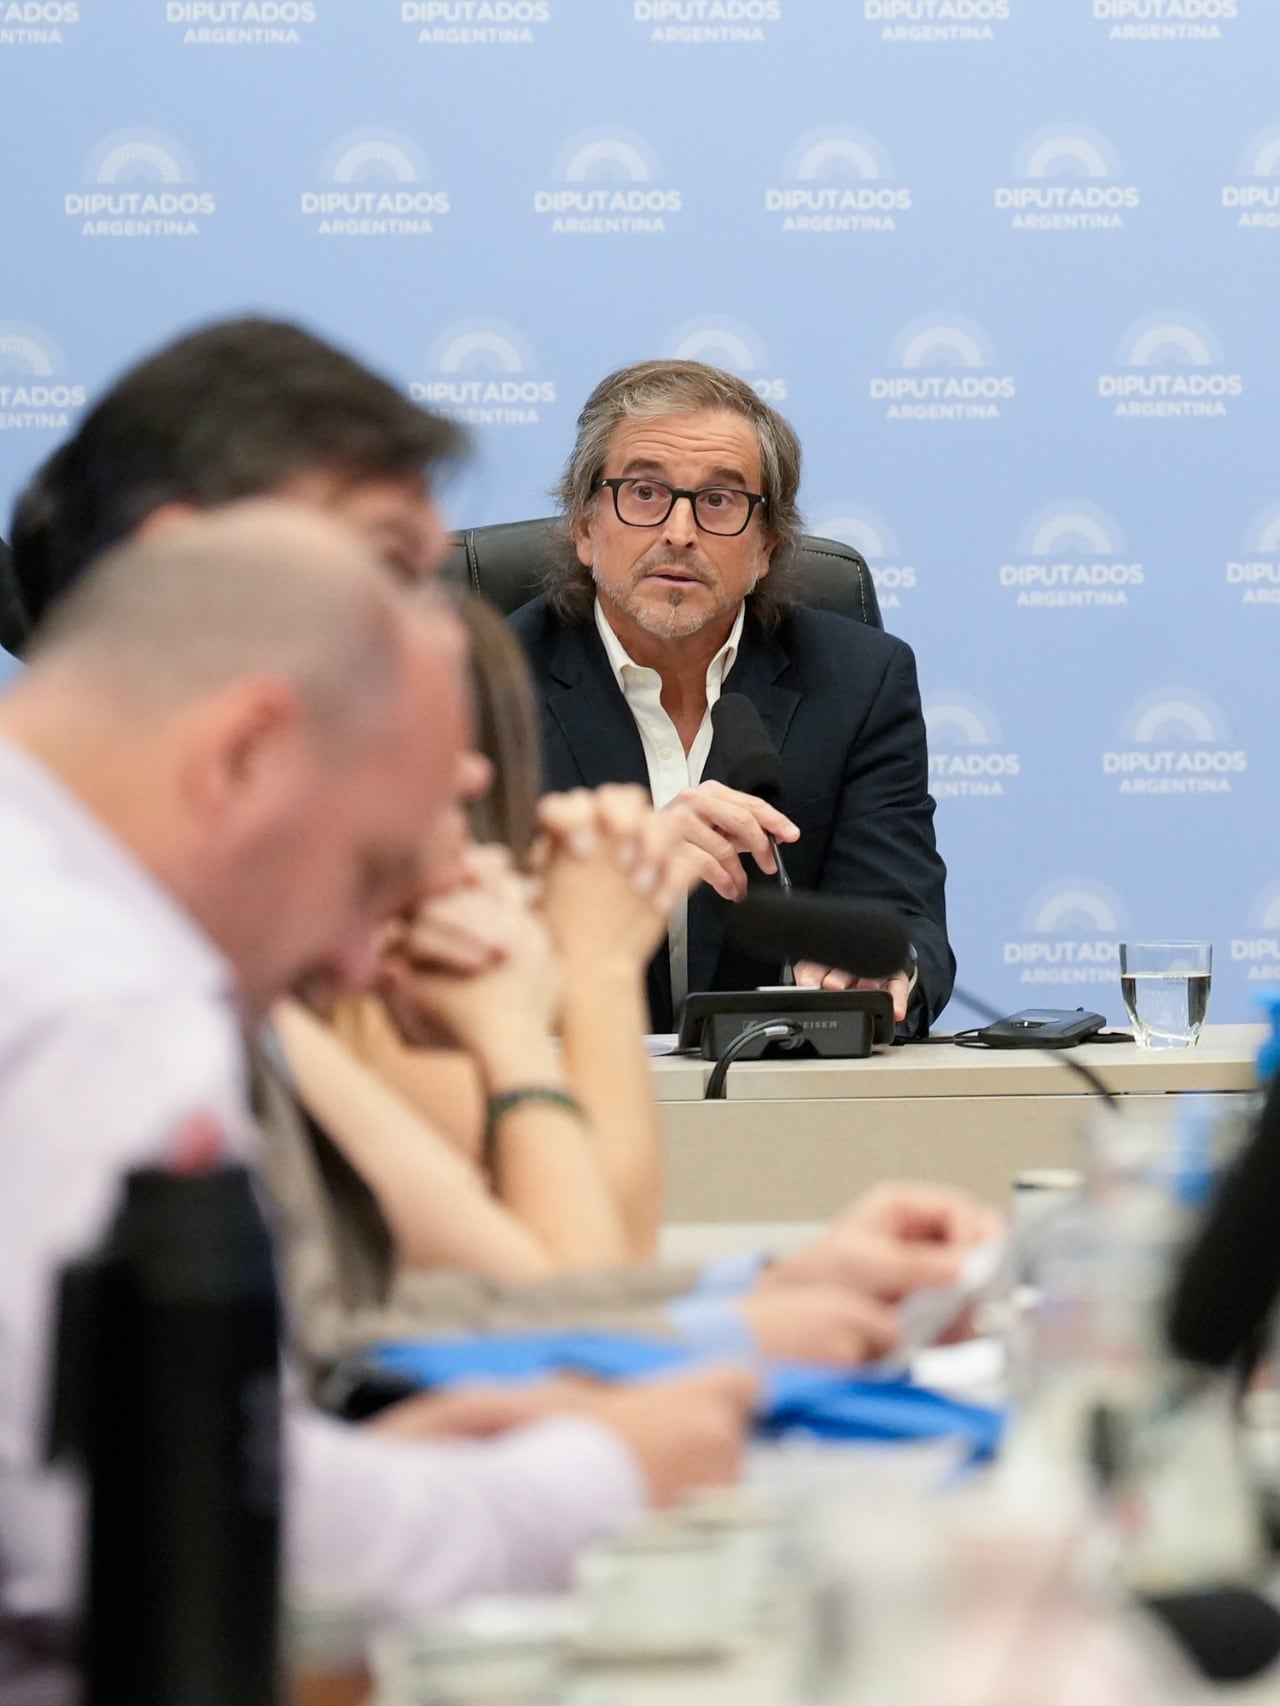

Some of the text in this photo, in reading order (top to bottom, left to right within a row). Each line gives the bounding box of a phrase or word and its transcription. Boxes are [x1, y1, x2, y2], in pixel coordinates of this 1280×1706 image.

[166, 2, 316, 21] DIPUTADOS
[401, 2, 551, 21] DIPUTADOS
[633, 0, 781, 20] DIPUTADOS
[864, 0, 1010, 18] DIPUTADOS
[1092, 0, 1238, 17] DIPUTADOS
[0, 28, 63, 44] NTINA
[184, 29, 301, 44] ARGENTINA
[418, 28, 534, 43] ARGENTINA
[651, 27, 765, 42] ARGENTINA
[881, 26, 994, 41] ARGENTINA
[1109, 25, 1222, 39] ARGENTINA
[64, 194, 216, 213] DIPUTADOS
[300, 193, 451, 212] DIPUTADOS
[534, 191, 682, 211] DIPUTADOS
[765, 189, 912, 209] DIPUTADOS
[994, 188, 1140, 207] DIPUTADOS
[82, 220, 199, 236] ARGENTINA
[318, 219, 434, 235] ARGENTINA
[551, 218, 666, 233] ARGENTINA
[781, 216, 896, 231] ARGENTINA
[1011, 214, 1124, 229] ARGENTINA
[408, 382, 556, 402] DIPUTADOS
[869, 378, 1016, 397] DIPUTADOS
[1097, 375, 1243, 395] DIPUTADOS
[0, 386, 87, 407] TADOS
[886, 404, 1000, 419] ARGENTINA
[1114, 402, 1227, 417] ARGENTINA
[0, 412, 69, 429] ENTINA
[999, 564, 1145, 584] DIPUTADOS
[1016, 591, 1128, 606] ARGENTINA
[929, 754, 1021, 776] TADOS
[1102, 752, 1248, 772] DIPUTADOS
[1119, 778, 1231, 793] ARGENTINA
[1003, 942, 1119, 964] DIPUTAD
[1020, 968, 1120, 983] ARGENTIN
